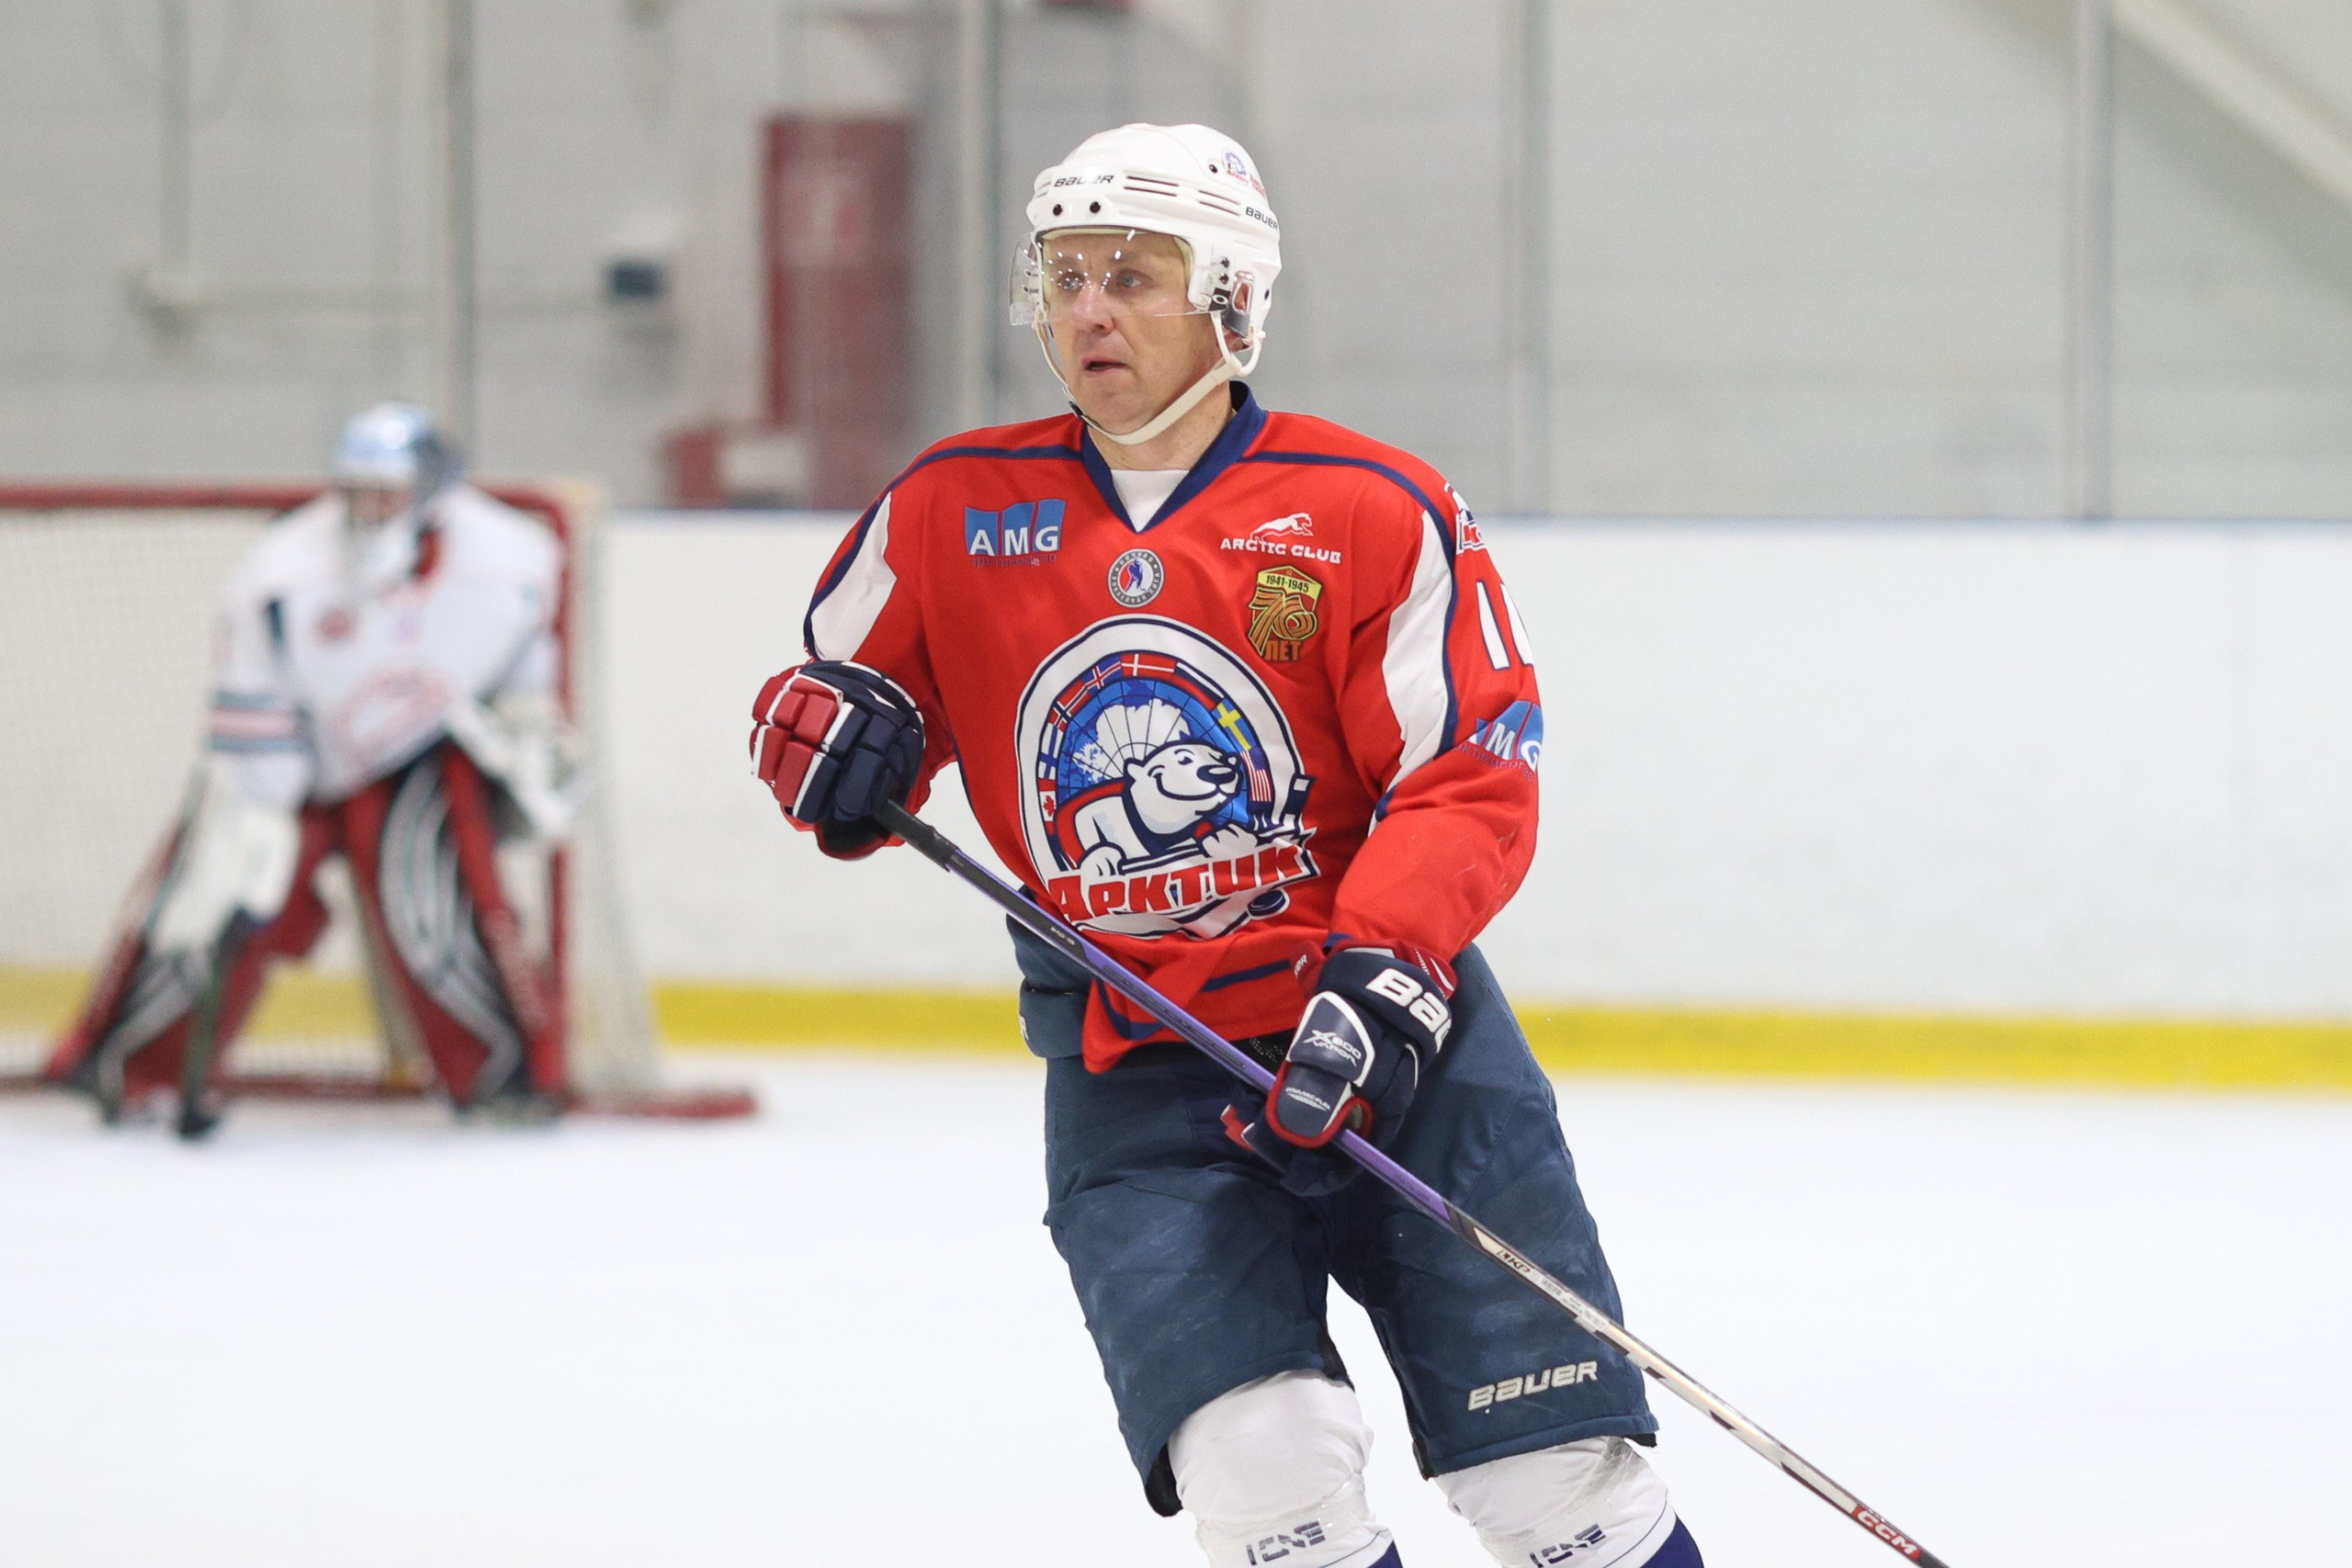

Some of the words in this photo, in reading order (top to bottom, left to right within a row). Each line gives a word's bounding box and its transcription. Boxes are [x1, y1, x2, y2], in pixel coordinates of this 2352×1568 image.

[969, 525, 1059, 557] AMG
[1219, 537, 1287, 556] ARCTIC
[1290, 544, 1342, 565] CLUB
[1265, 574, 1310, 593] 1941-1945
[1248, 586, 1317, 657] 70
[1263, 639, 1302, 661] ЛЕТ
[1467, 1360, 1599, 1412] BAUER
[1857, 1509, 1918, 1556] CCM
